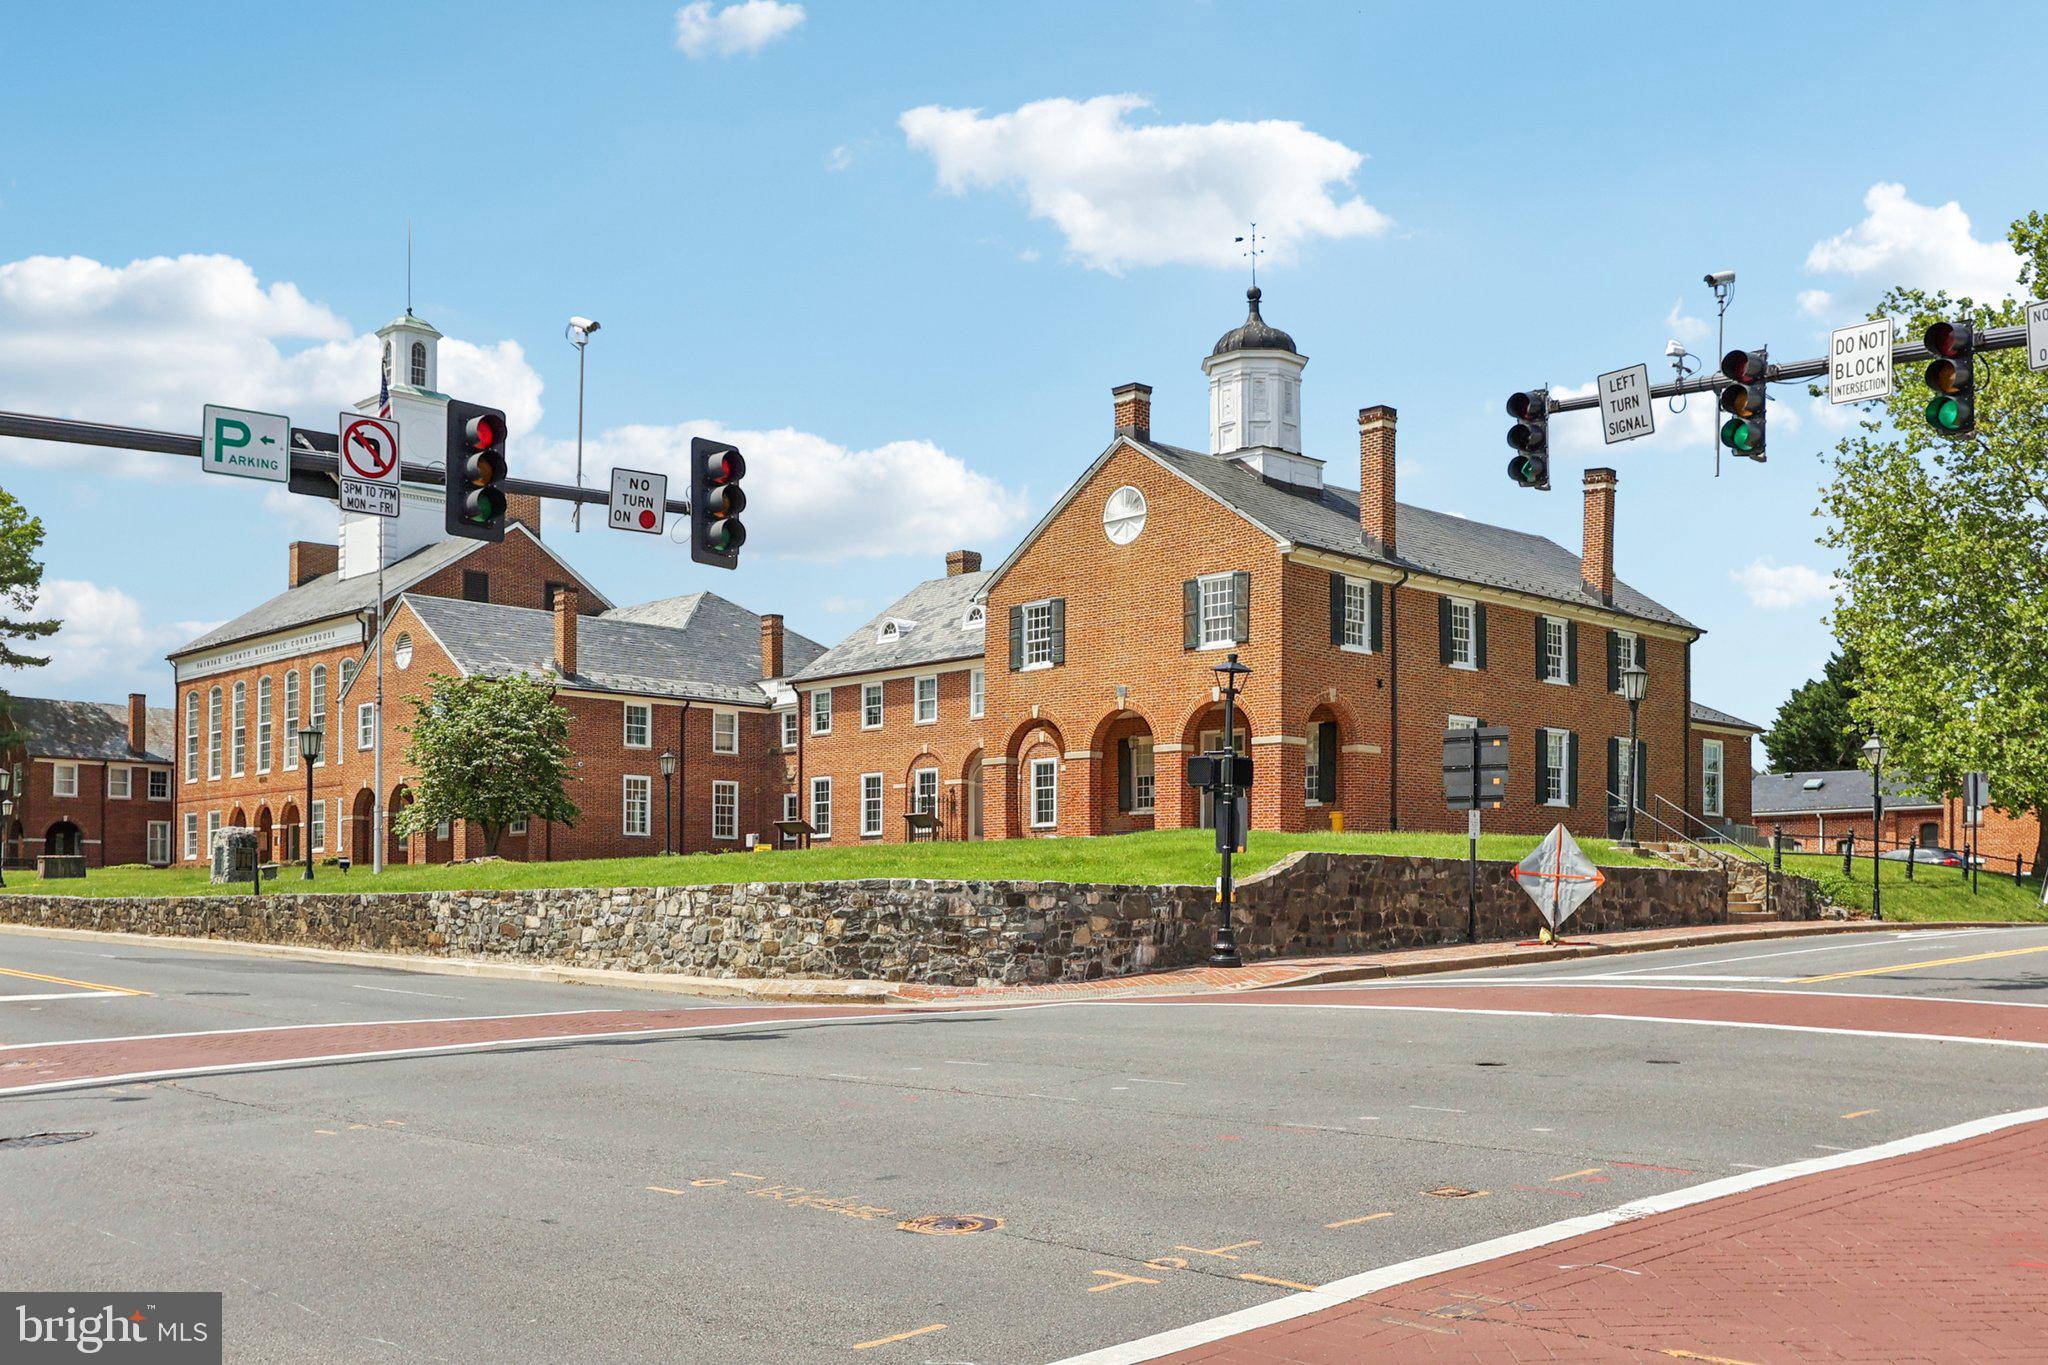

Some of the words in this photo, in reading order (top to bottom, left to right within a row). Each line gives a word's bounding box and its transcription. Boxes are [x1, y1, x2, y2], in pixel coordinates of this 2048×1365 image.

[1836, 336, 1854, 356] DO
[1859, 329, 1886, 351] NOT
[1835, 355, 1885, 380] BLOCK
[1609, 373, 1635, 393] LEFT
[1834, 377, 1886, 397] INTERSECTION
[1610, 395, 1639, 413] TURN
[1608, 415, 1648, 436] SIGNAL
[214, 417, 278, 471] PARKING
[343, 482, 362, 496] 3PM
[365, 485, 376, 497] TO
[378, 487, 397, 501] 7PM
[629, 477, 650, 491] NO
[346, 497, 366, 510] MON
[379, 501, 393, 514] FRI
[622, 493, 654, 509] TURN
[614, 509, 631, 522] ON
[196, 657, 221, 669] FAIRFAX
[225, 650, 251, 663] COUNTY
[254, 642, 287, 656] HISTORIC
[290, 630, 336, 647] COURTHOUSE
